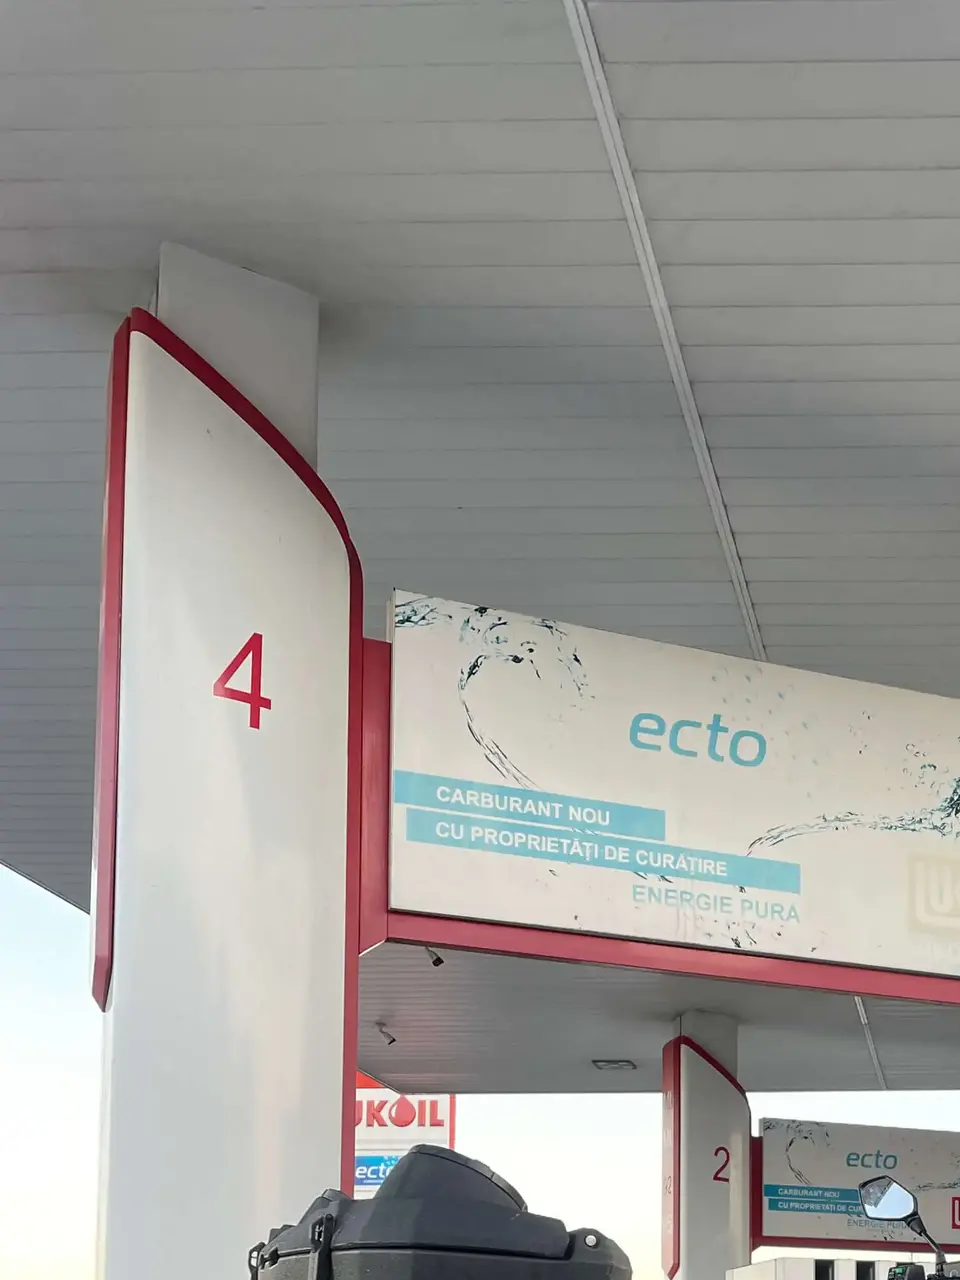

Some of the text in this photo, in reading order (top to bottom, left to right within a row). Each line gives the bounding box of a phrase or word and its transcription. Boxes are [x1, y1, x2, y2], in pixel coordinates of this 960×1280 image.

[212, 632, 271, 729] 4
[629, 712, 767, 767] ecto
[436, 786, 611, 826] CARBURANT NOU
[435, 821, 464, 840] CU
[605, 844, 630, 863] DE
[632, 884, 733, 915] ENERGIE
[713, 1146, 730, 1182] 2
[846, 1150, 898, 1170] ecto
[778, 1188, 822, 1198] CARBURANT
